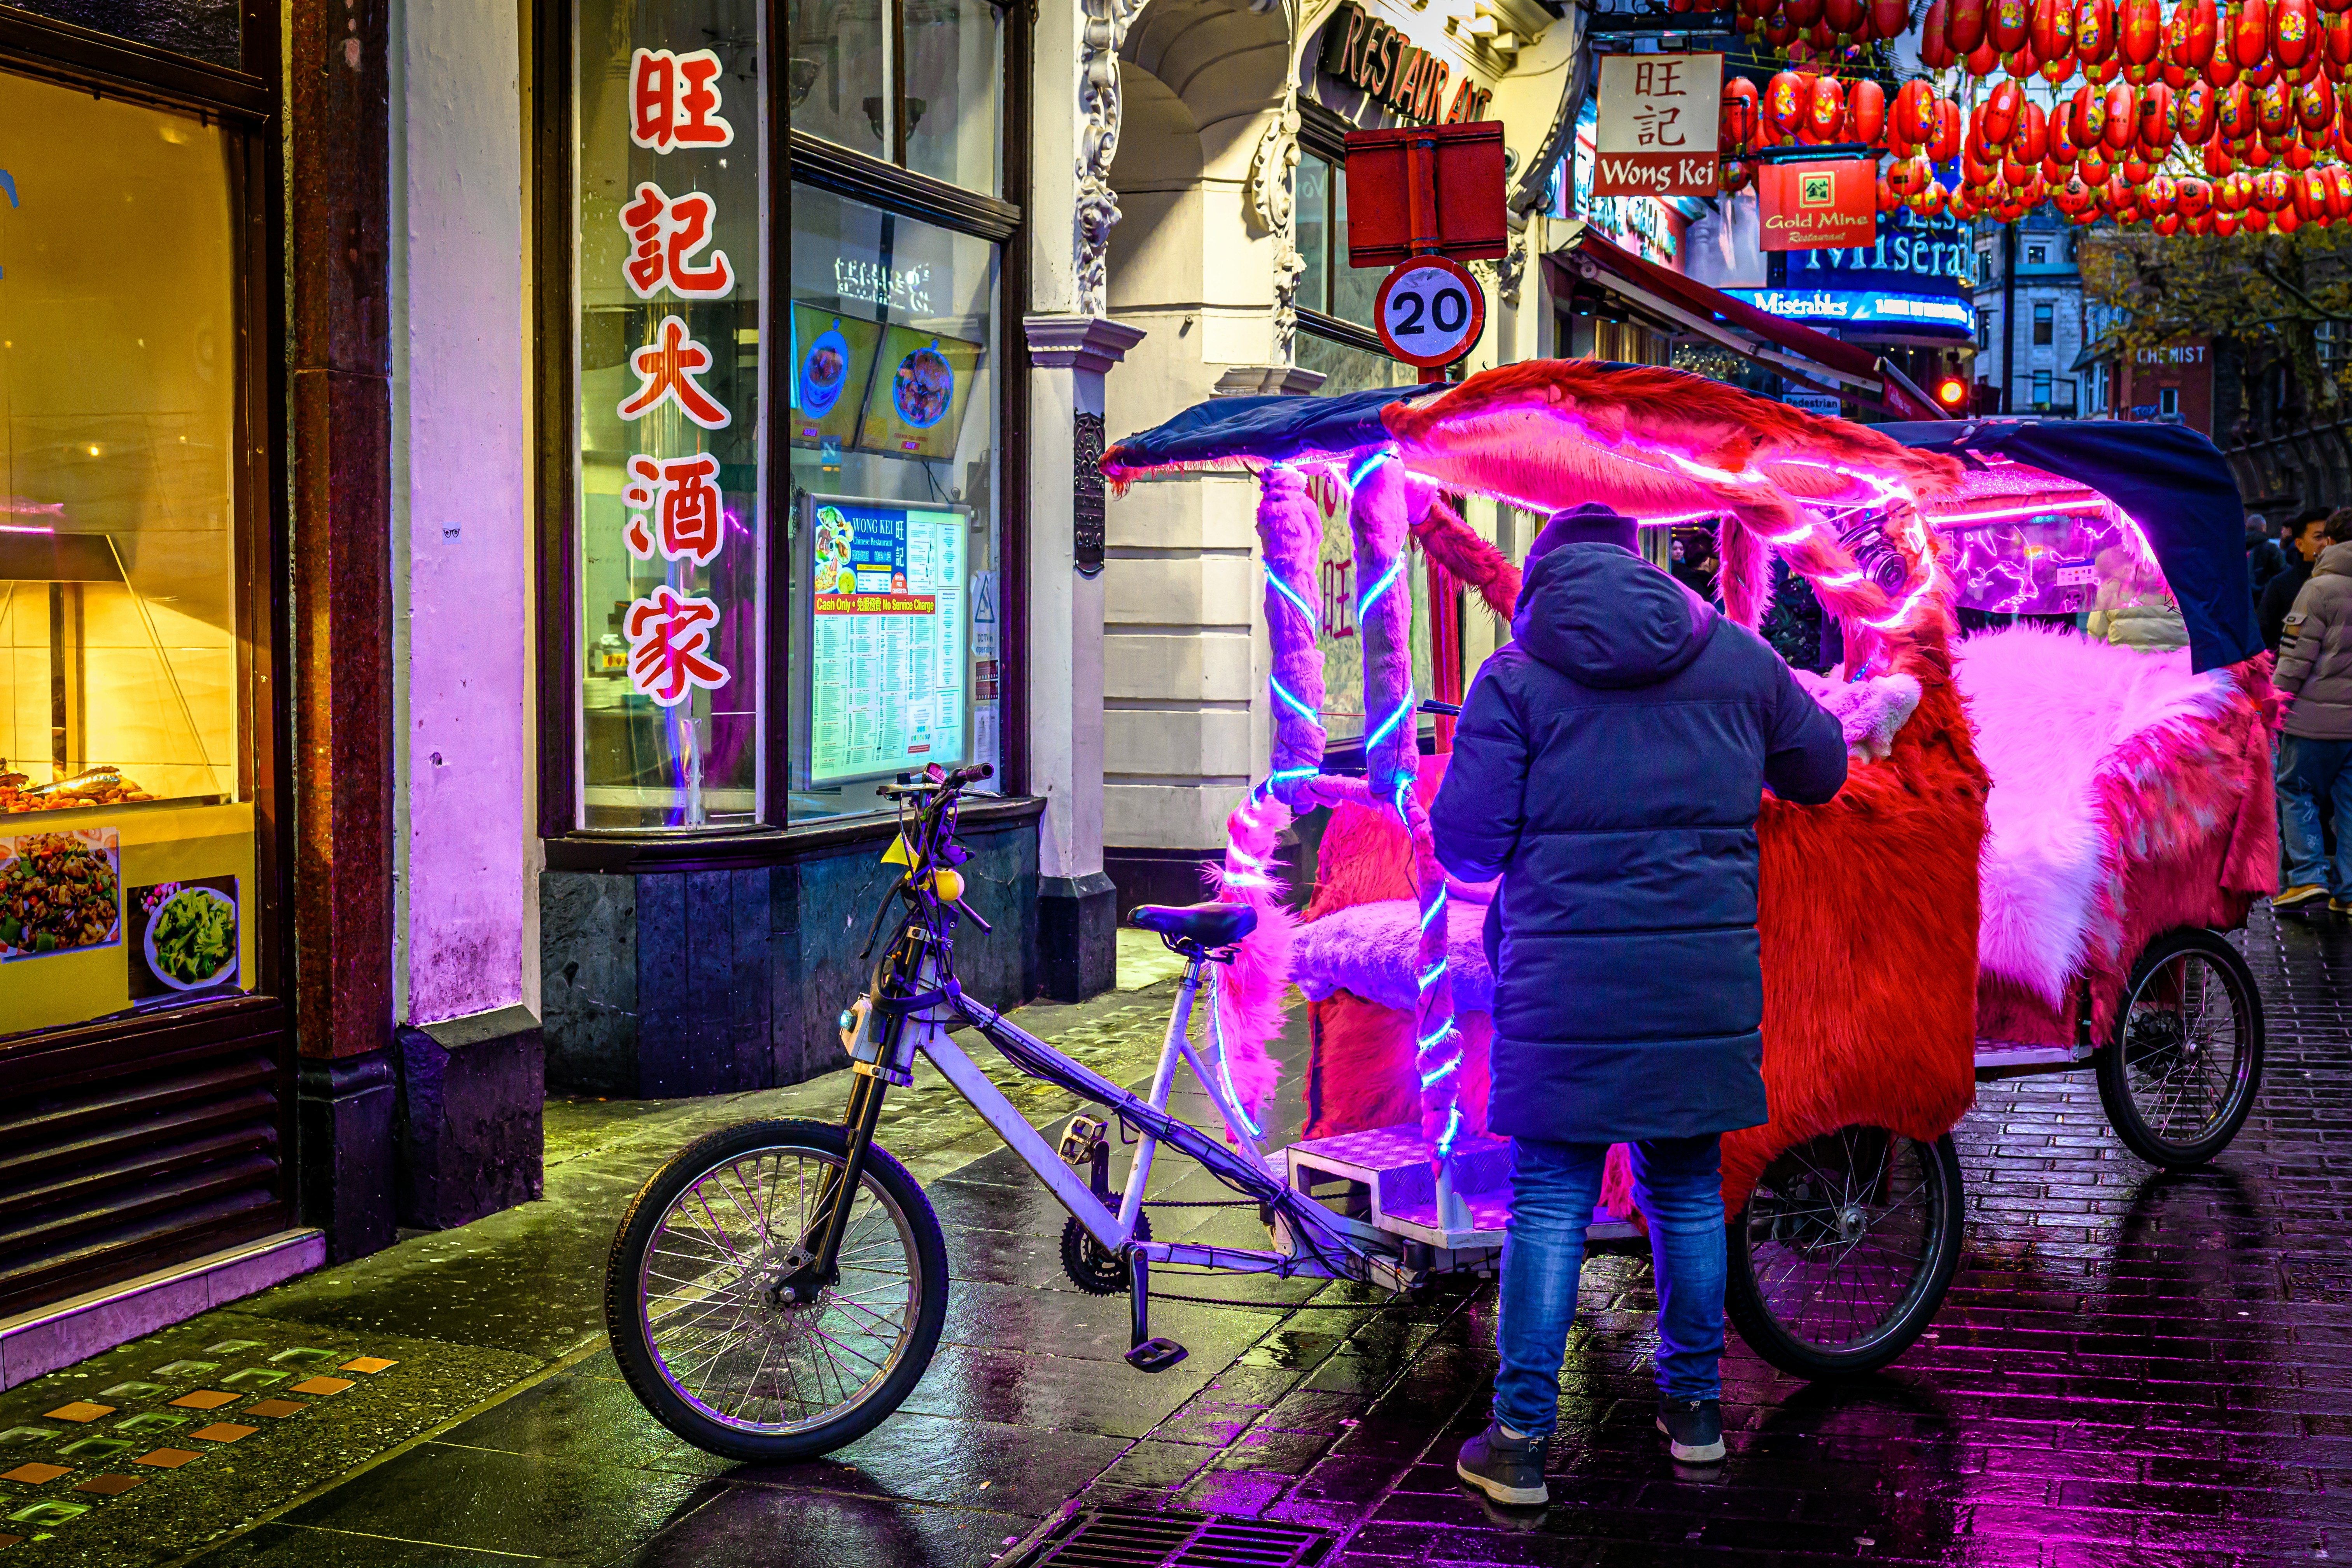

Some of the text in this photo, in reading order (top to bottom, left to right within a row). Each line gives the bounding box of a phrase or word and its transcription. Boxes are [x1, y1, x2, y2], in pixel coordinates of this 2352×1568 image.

[1341, 5, 1493, 125] RESTAURANT
[1634, 60, 1687, 147] 旺記
[1600, 158, 1672, 192] Wong
[1679, 158, 1713, 185] Kei
[1766, 212, 1869, 229] Gold Mine
[1789, 231, 1846, 243] Restaurant
[1392, 287, 1467, 336] 20
[2137, 346, 2206, 363] CHEMIST
[618, 48, 734, 707] 旺記大酒家
[1786, 397, 1838, 408] Pedestrian
[852, 518, 893, 535] WONG KEI
[853, 536, 893, 546] Chinese Restaurant
[896, 520, 905, 567] 旺記
[817, 598, 851, 612] Cash Only
[883, 597, 934, 612] No Service Charge
[1323, 559, 1353, 639] 旺
